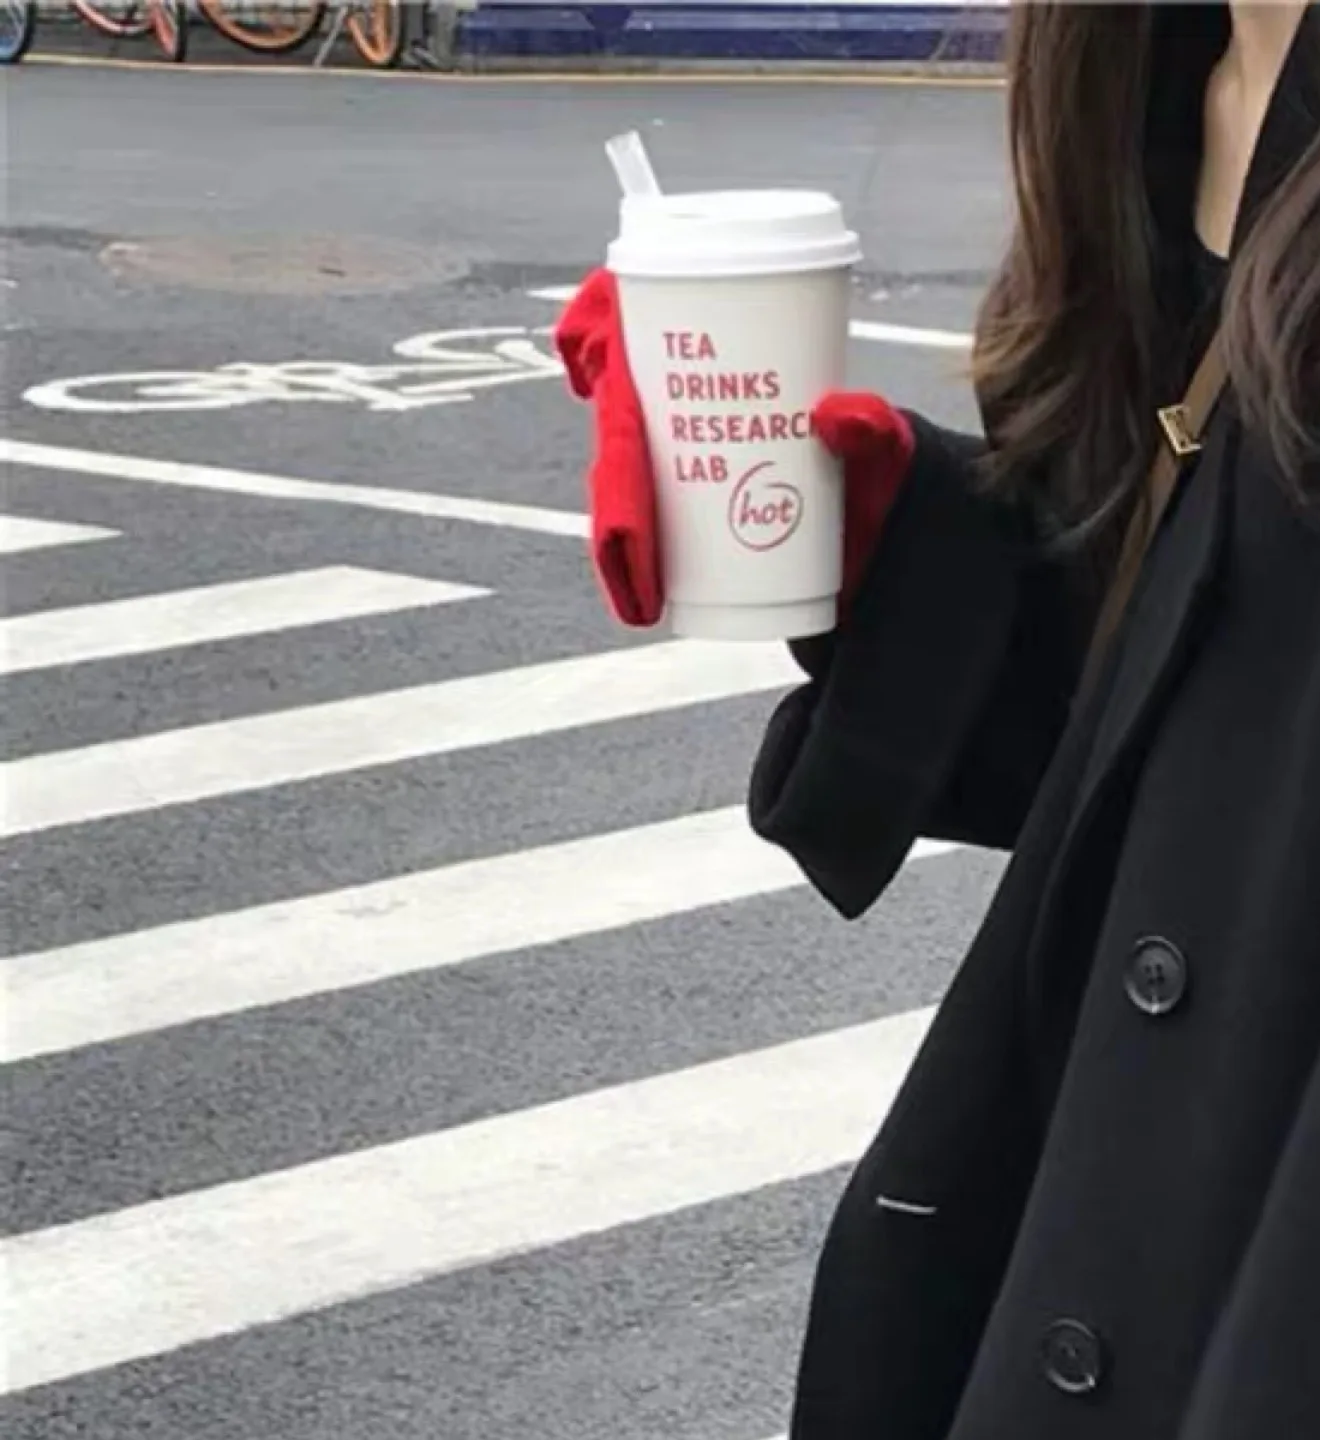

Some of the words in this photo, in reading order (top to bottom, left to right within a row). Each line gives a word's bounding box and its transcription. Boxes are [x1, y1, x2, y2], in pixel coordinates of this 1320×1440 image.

[663, 332, 716, 360] TEA
[666, 370, 780, 400] DRINKS
[675, 455, 728, 483] LAB
[738, 491, 794, 526] hot
